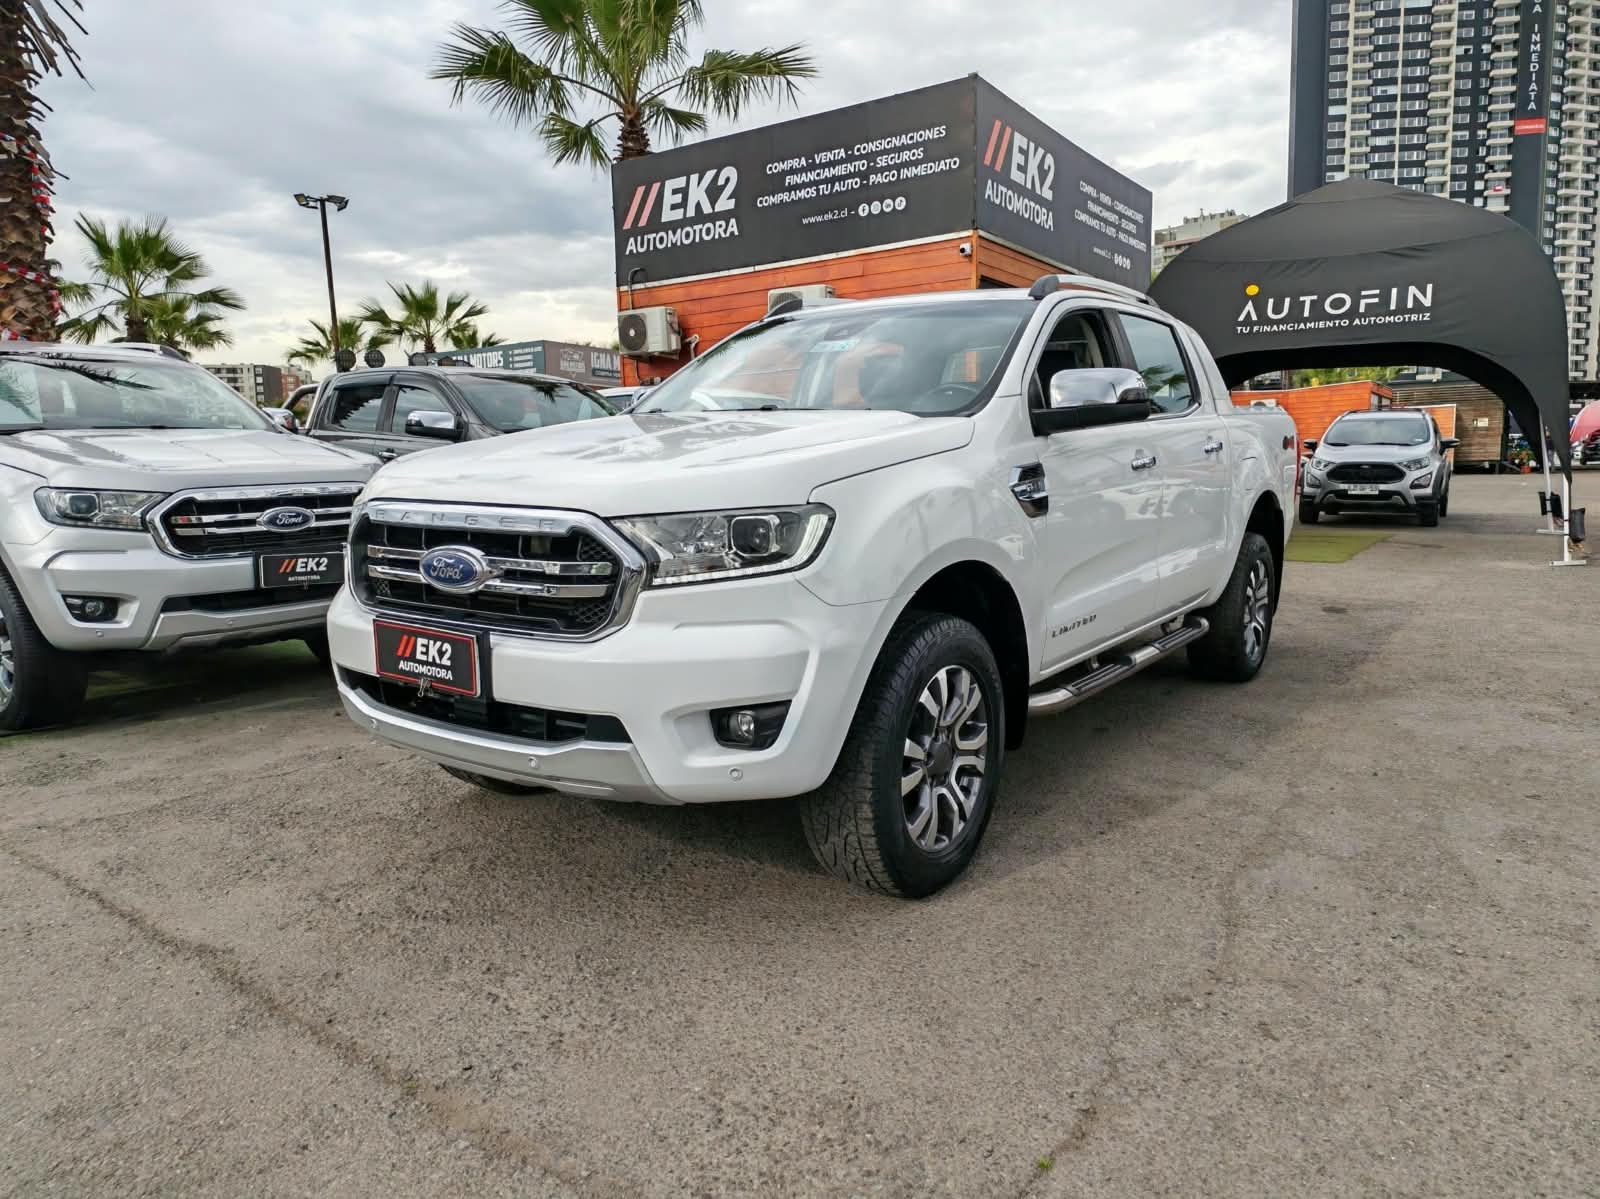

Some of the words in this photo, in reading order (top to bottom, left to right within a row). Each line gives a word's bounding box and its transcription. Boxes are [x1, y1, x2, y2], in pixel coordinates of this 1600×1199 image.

[1527, 23, 1541, 111] INMEDIATA
[766, 157, 807, 174] COMPRA
[814, 148, 846, 164] VENTA
[854, 125, 947, 156] CONSIGNACIONES
[756, 186, 817, 208] COMPRAMOS
[818, 184, 831, 195] TU
[832, 178, 861, 193] AUTO
[869, 170, 898, 186] PAGO
[900, 157, 960, 179] INMEDIATO
[785, 159, 868, 186] FINANCIAMIENTO
[876, 148, 924, 168] SEGUROS
[802, 208, 848, 225] www.ek2.cl
[984, 179, 1054, 231] AUTOMOTORA
[625, 218, 739, 255] AUTOMOTORA
[1237, 284, 1433, 322] AUTOFIN
[1236, 326, 1250, 334] TU
[1253, 319, 1350, 333] FINANCIAMIENTO
[1352, 312, 1432, 326] AUTOMOTRIZ
[469, 351, 504, 369] MOTORS
[276, 512, 303, 525] Ford
[375, 509, 555, 530] RANGER
[431, 555, 463, 580] Ford
[398, 660, 453, 681] AUTOMOTORA
